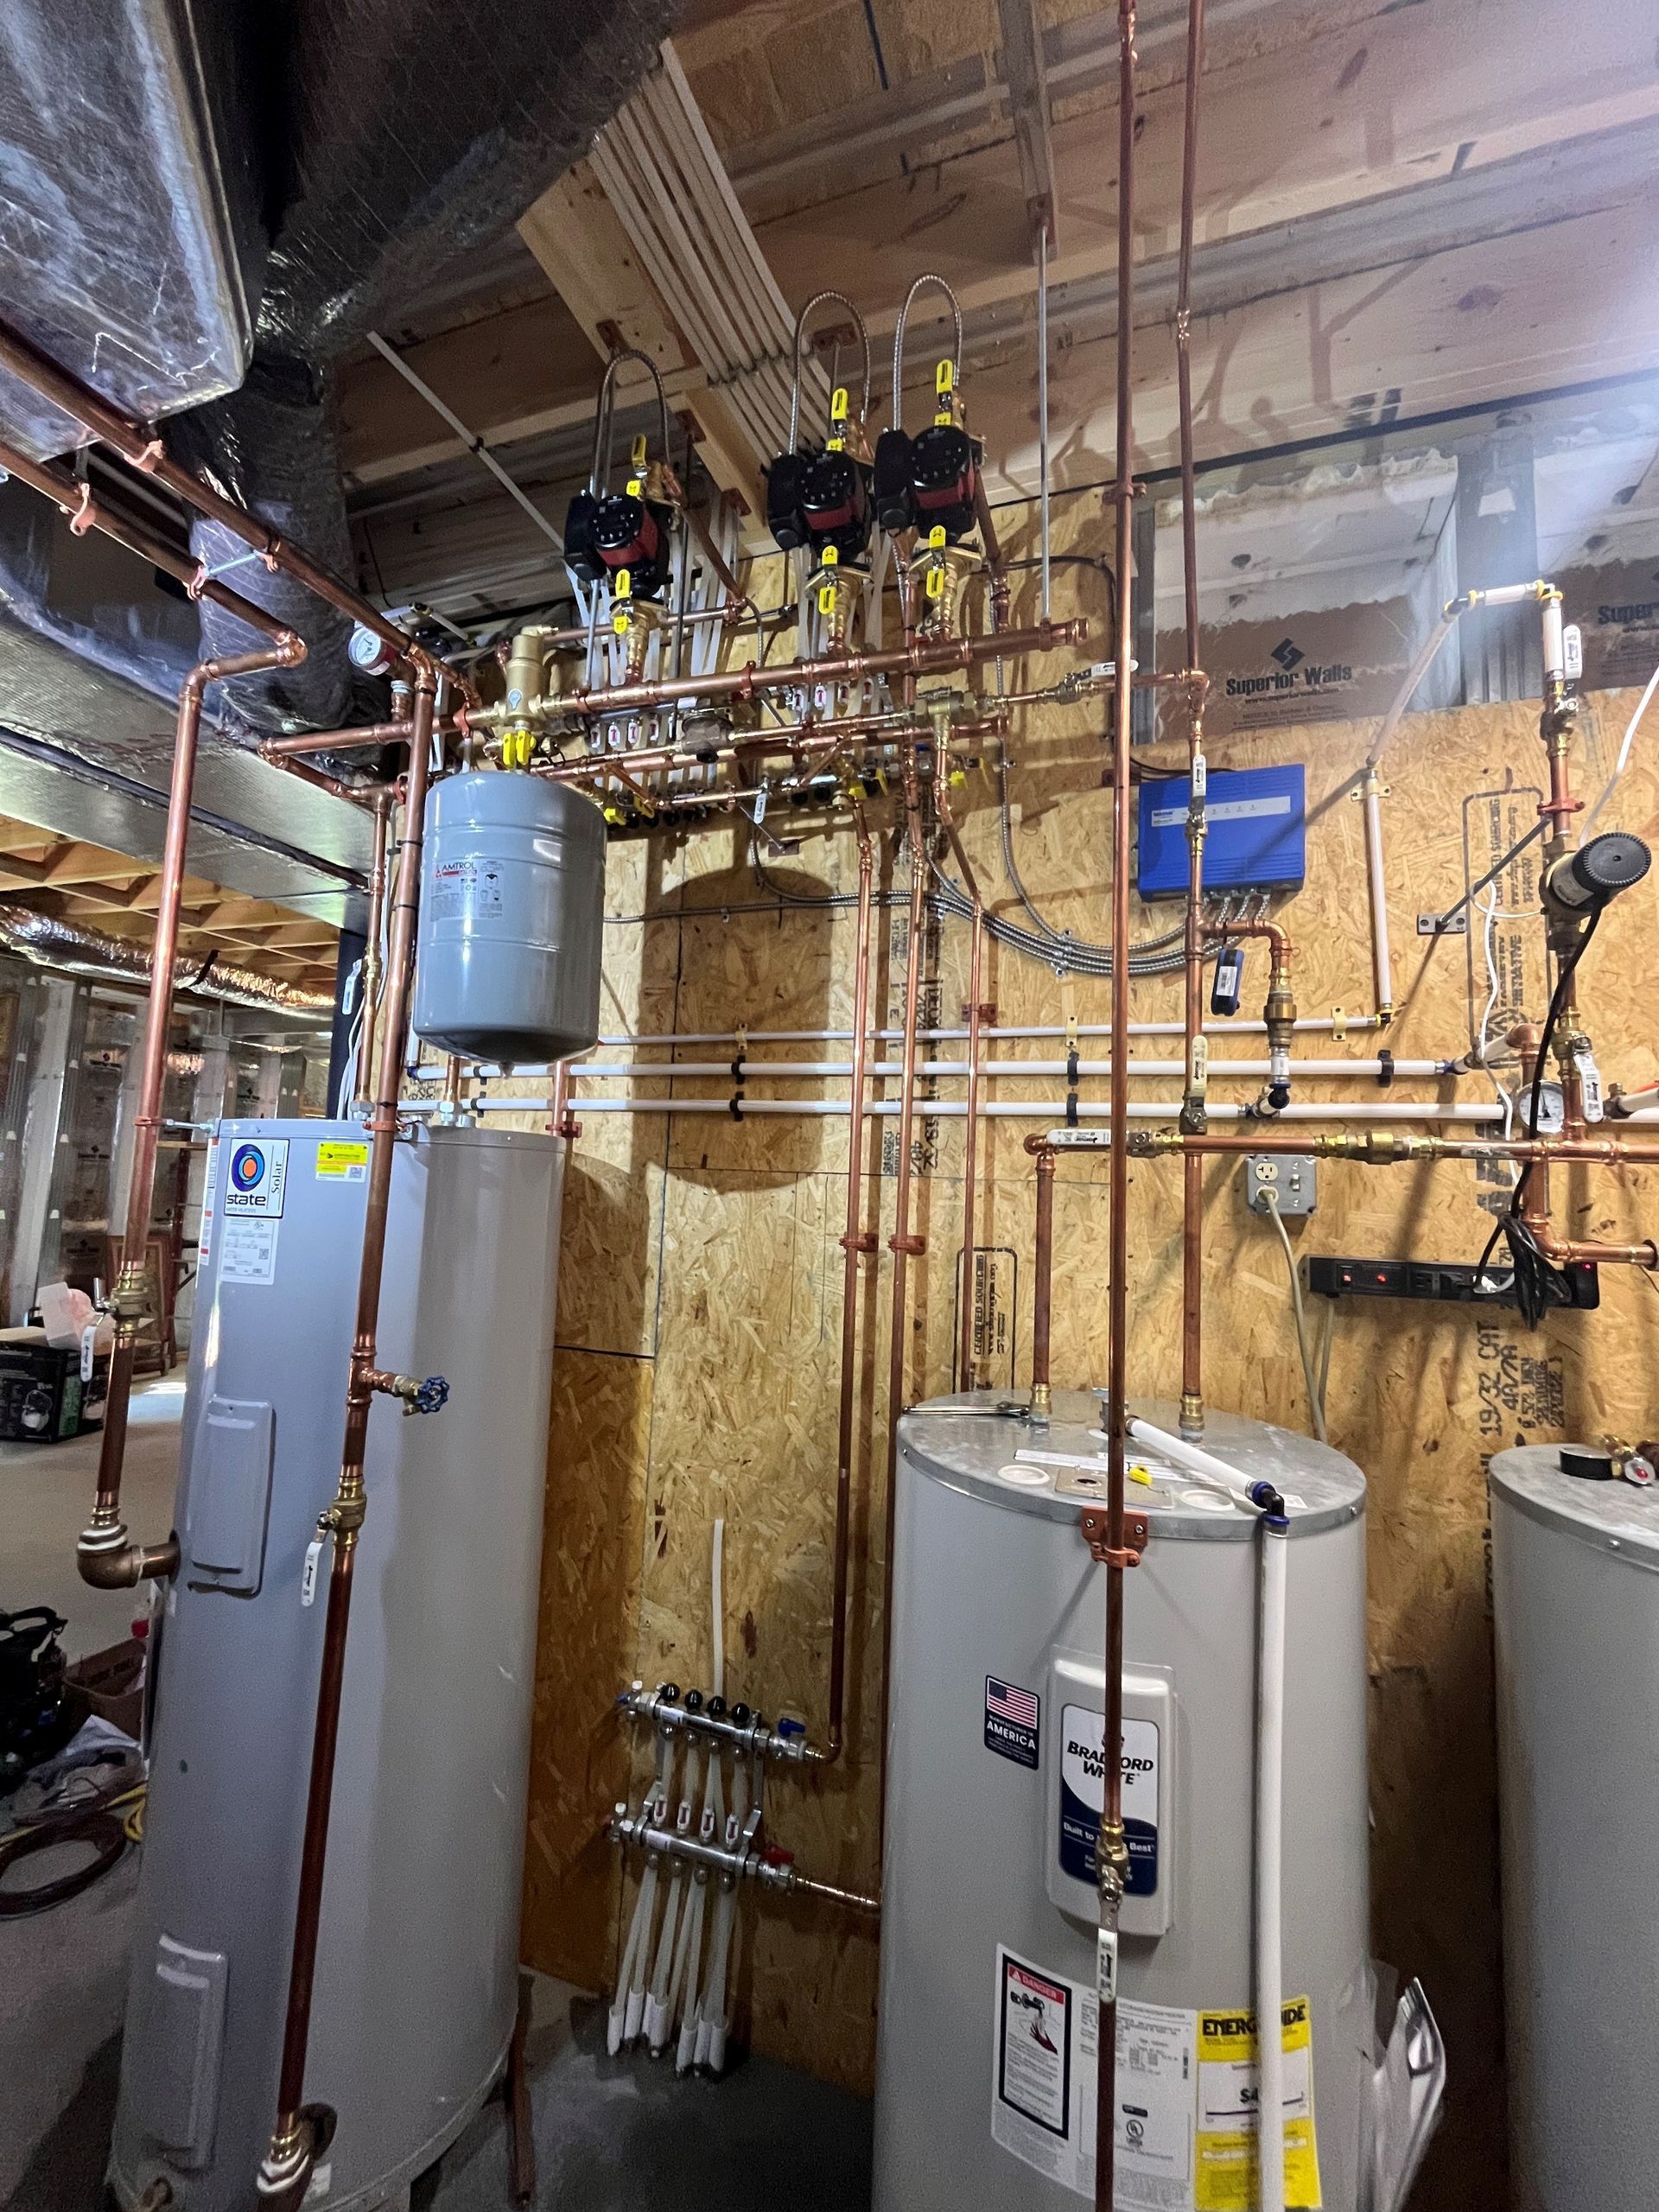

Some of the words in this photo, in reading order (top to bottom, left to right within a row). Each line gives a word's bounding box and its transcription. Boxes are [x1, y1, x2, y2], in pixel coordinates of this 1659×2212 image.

[1225, 671, 1299, 696] Superior
[1305, 664, 1352, 685] Walls
[442, 861, 477, 872] AMTROL
[271, 1160, 283, 1193] Solar
[226, 1193, 266, 1206] state
[1477, 1320, 1499, 1359] CAT
[1478, 1372, 1502, 1437] 19/32
[987, 1720, 1036, 1750] AMERICA
[1063, 1821, 1084, 1838] Built
[1085, 1831, 1095, 1840] to
[1129, 1842, 1152, 1853] Best
[1022, 1975, 1057, 1999] DANGER
